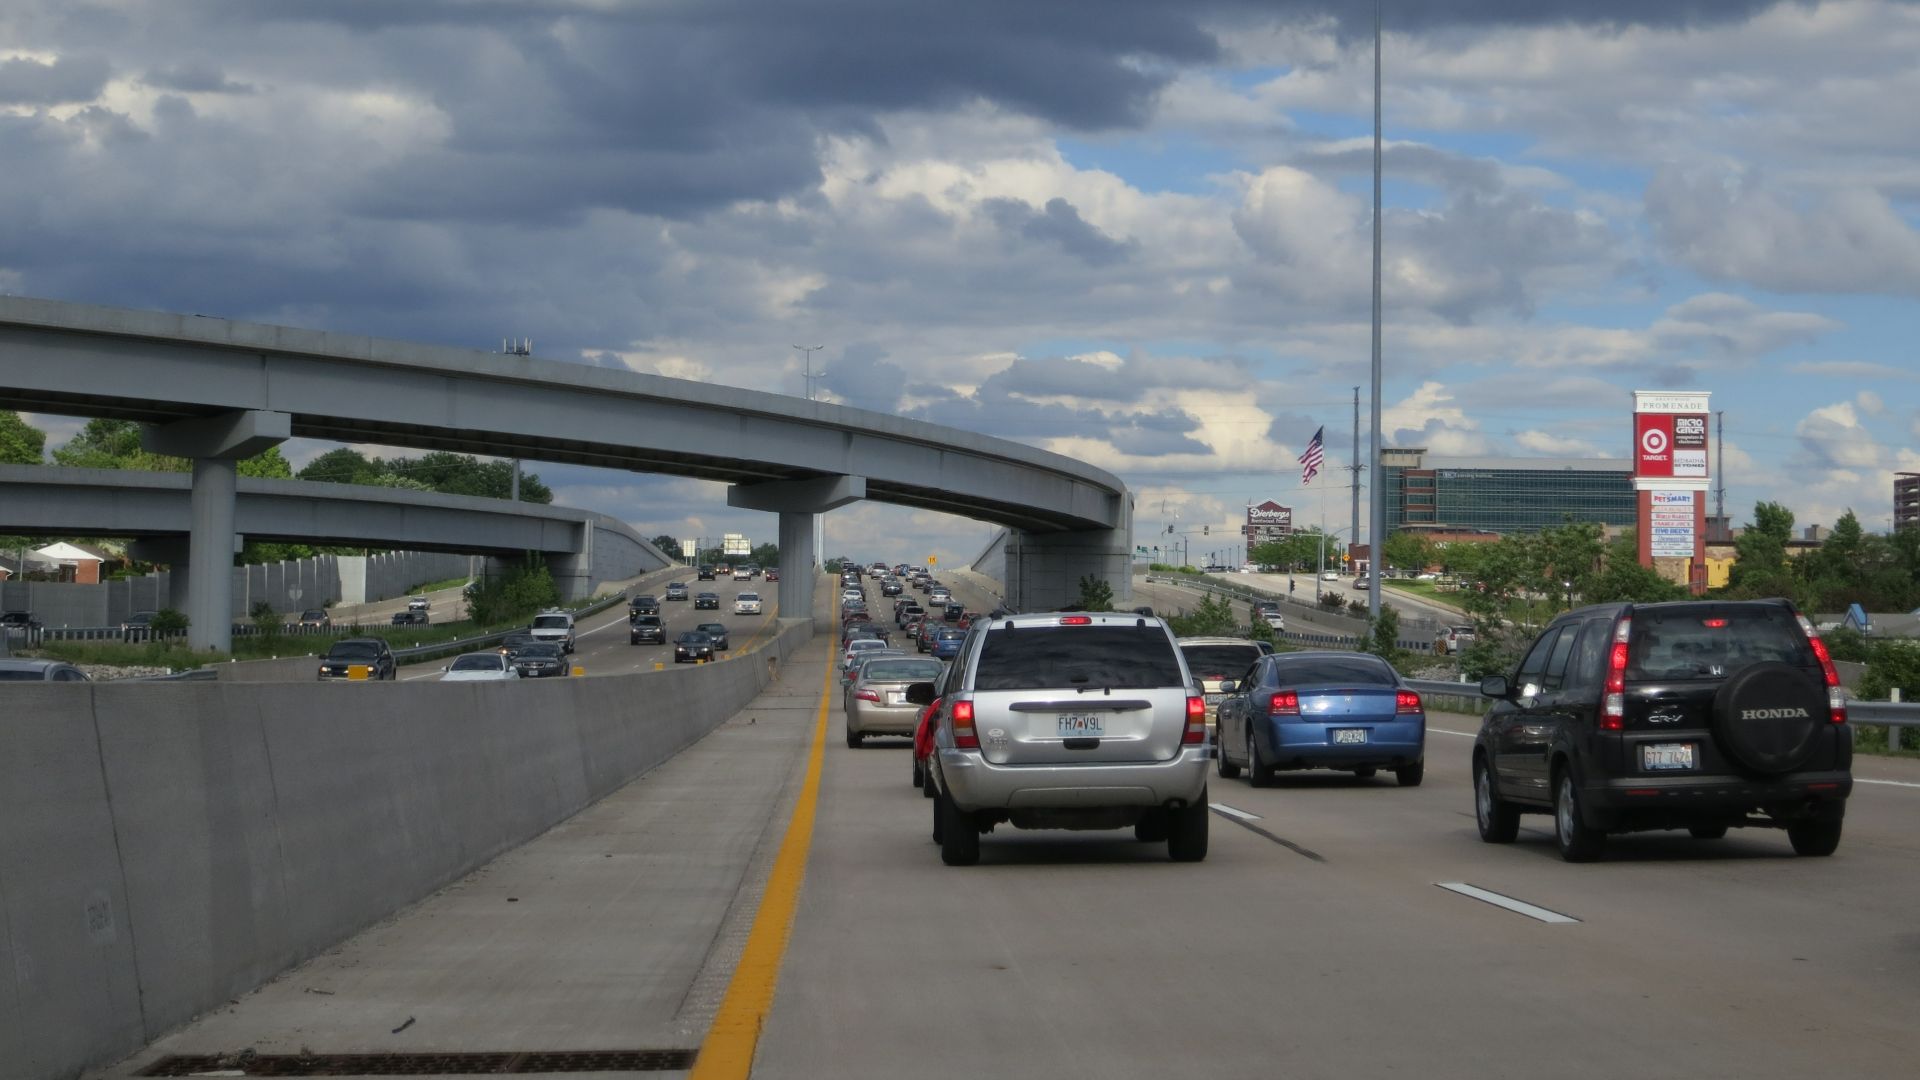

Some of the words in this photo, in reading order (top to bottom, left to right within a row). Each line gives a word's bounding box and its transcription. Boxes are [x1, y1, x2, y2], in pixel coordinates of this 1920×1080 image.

[1677, 418, 1703, 426] MICRO
[1250, 508, 1290, 519] Dierbergs
[1741, 707, 1810, 720] HONDA
[1648, 715, 1683, 723] CR-V
